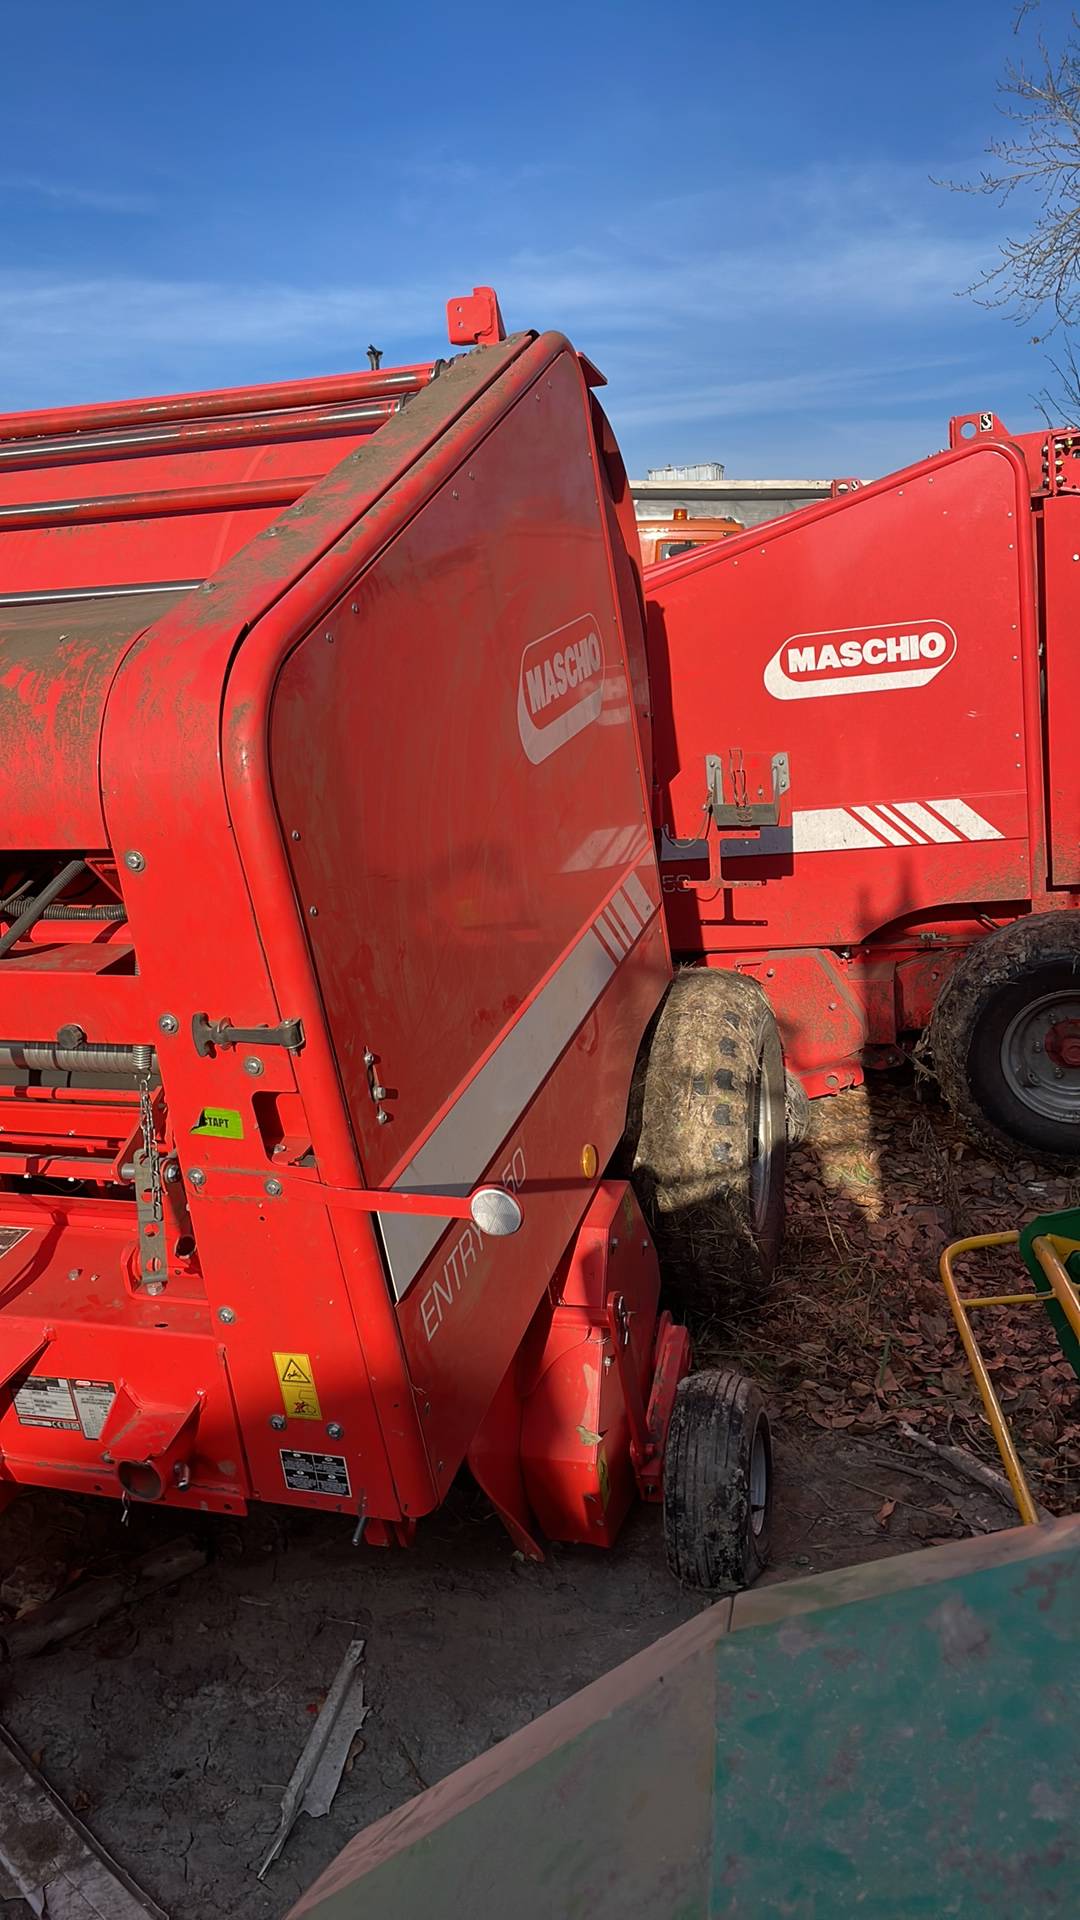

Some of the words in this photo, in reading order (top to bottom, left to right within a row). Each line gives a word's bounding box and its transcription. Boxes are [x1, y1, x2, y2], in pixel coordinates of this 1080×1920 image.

[526, 632, 601, 714] MASCHIO
[787, 631, 946, 673] MASCHIO
[662, 874, 691, 893] 50
[420, 1221, 484, 1342] ENTRY
[501, 1147, 526, 1195] 50
